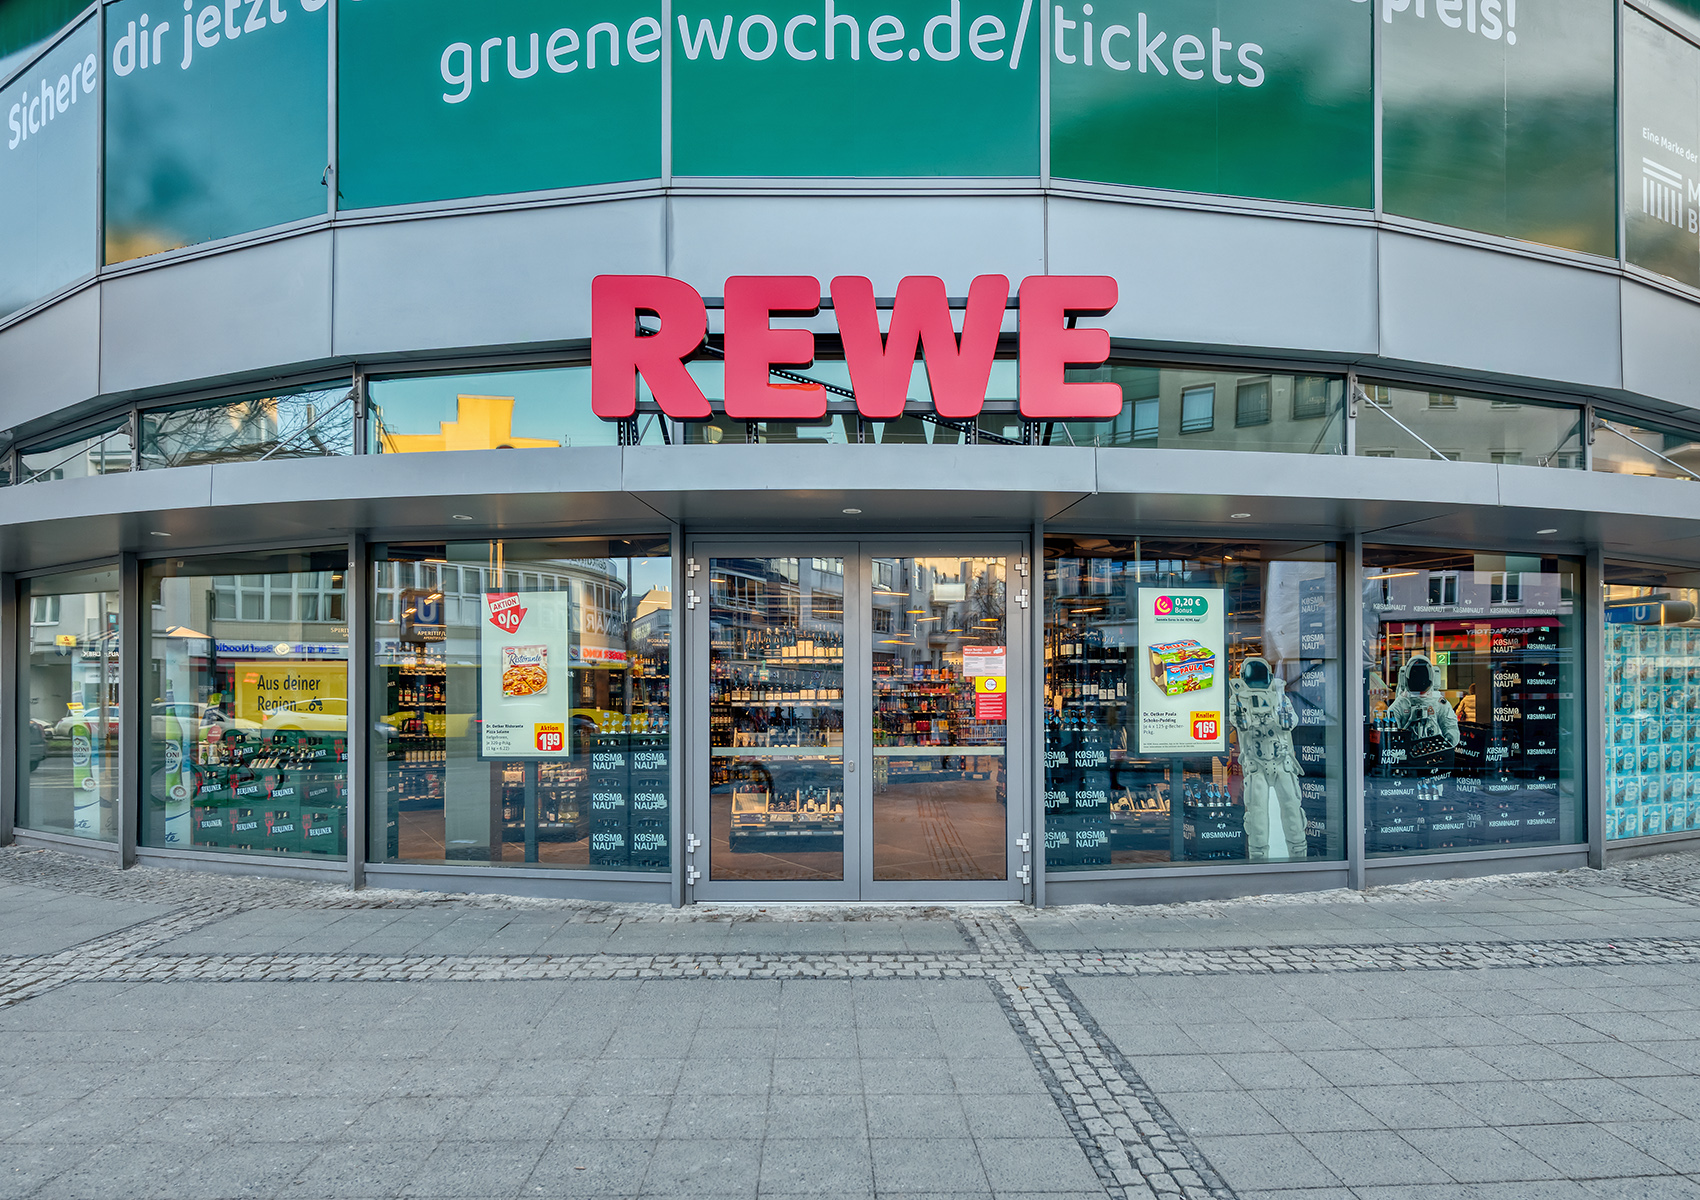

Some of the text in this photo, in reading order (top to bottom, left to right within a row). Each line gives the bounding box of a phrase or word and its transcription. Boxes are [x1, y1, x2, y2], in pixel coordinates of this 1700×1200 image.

[8, 53, 97, 150] Sichere
[112, 13, 170, 77] dir
[1642, 127, 1699, 164] Eine Marke der
[591, 274, 1123, 421] REWE
[492, 597, 518, 611] AKTION
[1175, 598, 1201, 607] 0,20 €
[1438, 654, 1446, 664] 2
[1180, 664, 1203, 674] PAULA
[257, 674, 321, 691] Aus deiner
[257, 696, 297, 715] Region
[201, 784, 222, 793] BERLINER
[237, 786, 258, 796] BERLINER
[272, 788, 294, 798] BERLINER
[201, 819, 223, 829] BERLINER
[236, 821, 258, 831] BERLINER
[272, 824, 294, 834] BERLINER
[309, 826, 332, 837] BERLINER
